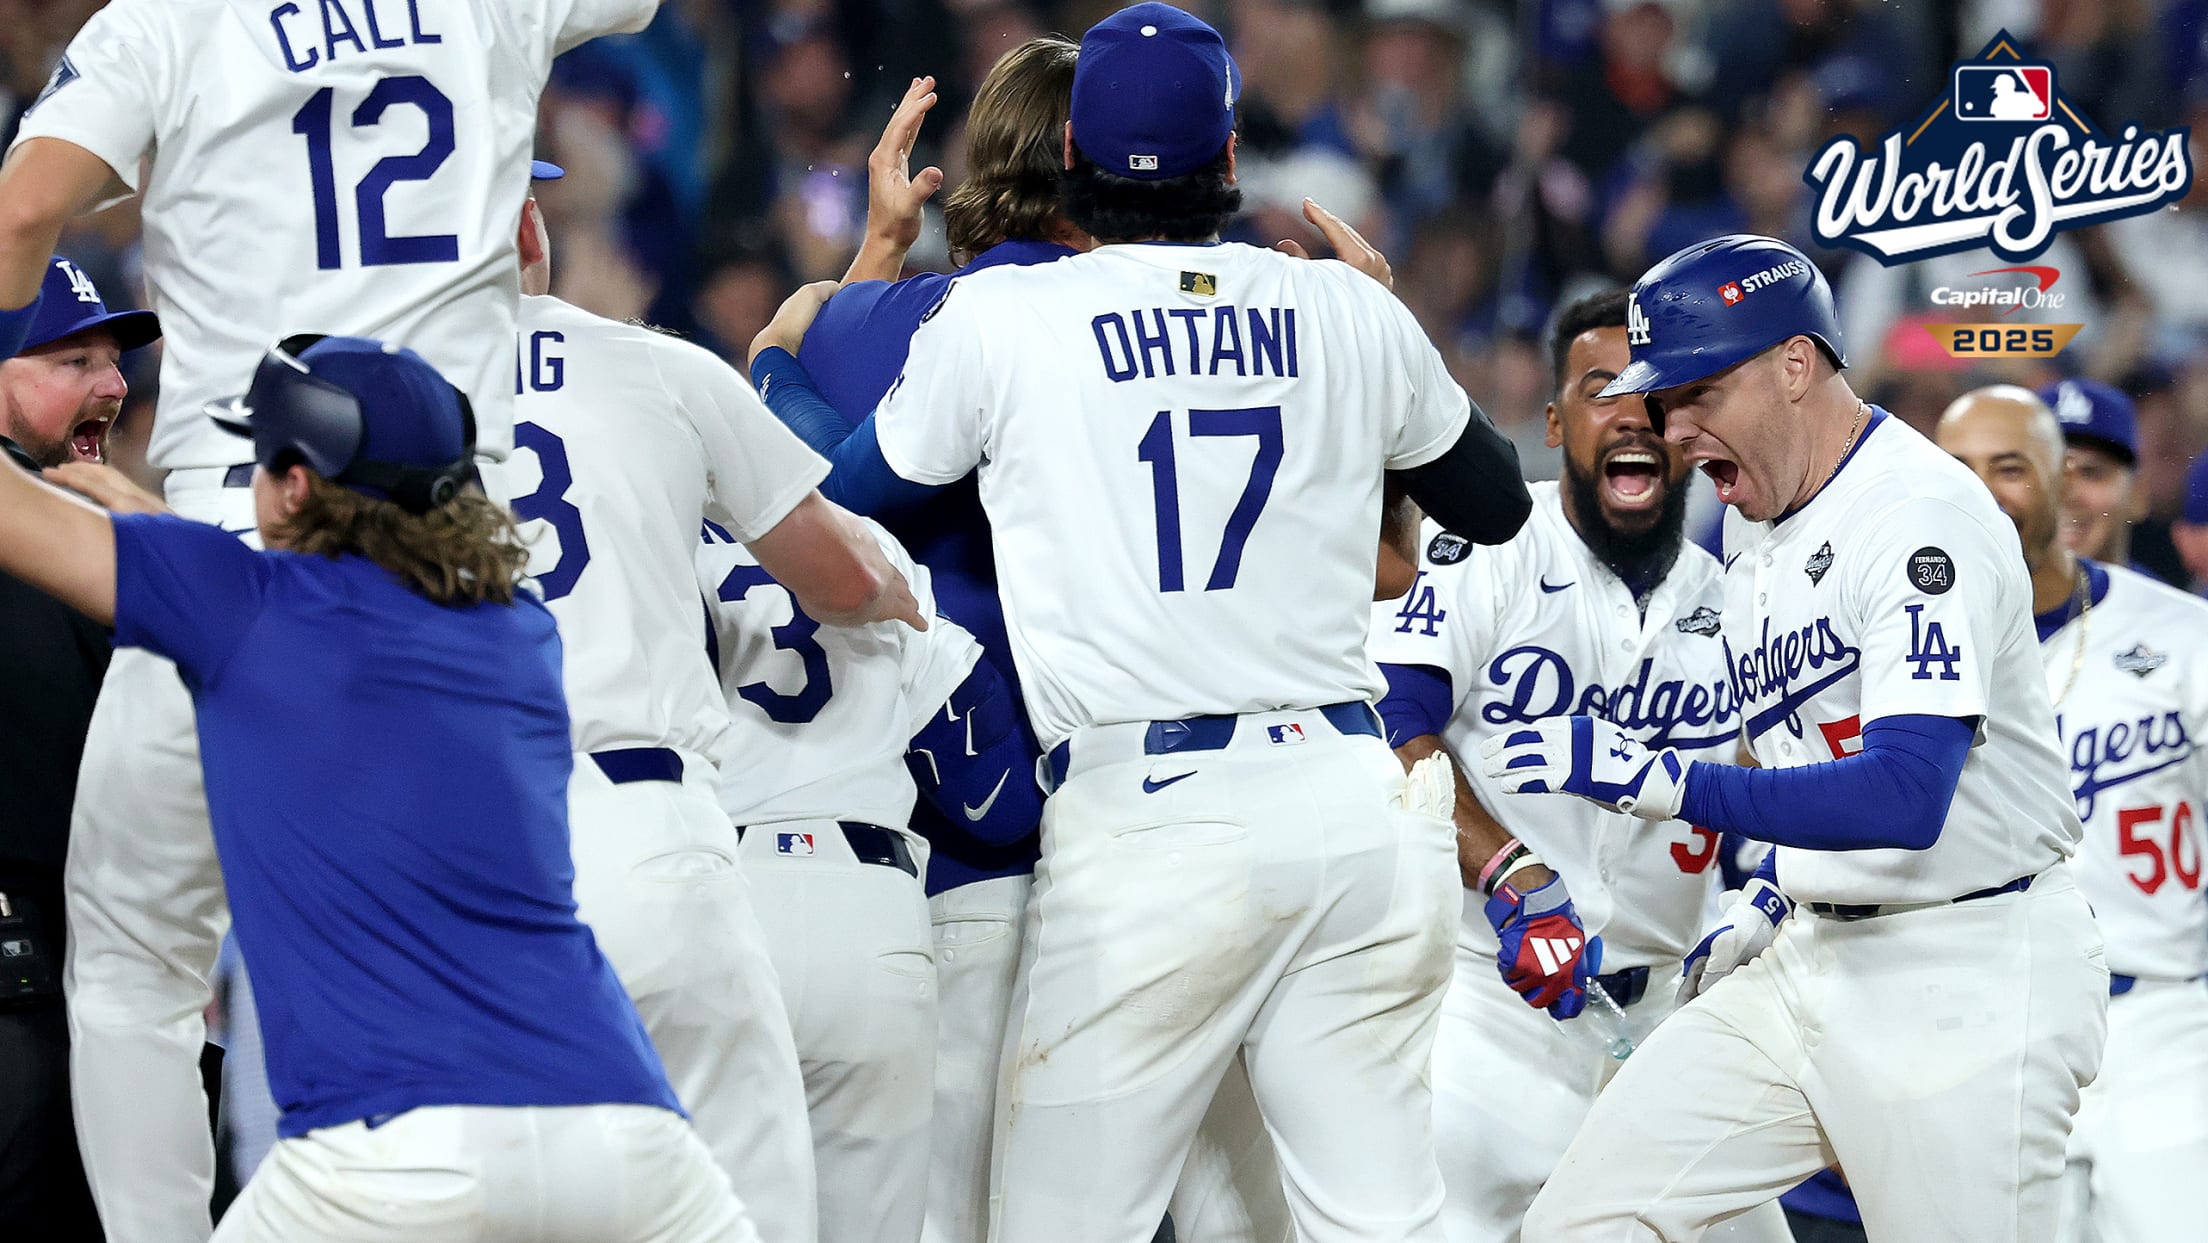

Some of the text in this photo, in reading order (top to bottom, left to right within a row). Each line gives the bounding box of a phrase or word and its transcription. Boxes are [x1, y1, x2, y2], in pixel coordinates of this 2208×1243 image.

[270, 0, 442, 73] CALL
[293, 75, 459, 270] 12
[56, 260, 100, 303] LA
[1741, 260, 1806, 293] STRAUSS
[1091, 306, 1298, 382] OHTANI
[1627, 293, 1651, 345] LA
[1138, 405, 1284, 592] 17
[1915, 556, 1947, 564] FERNANDO
[1917, 564, 1948, 586] 34
[1394, 571, 1446, 637] LA
[701, 565, 833, 724] 3
[1905, 604, 1961, 680] LA
[1722, 616, 1862, 739] odgers
[1670, 825, 1722, 874] 3
[2118, 801, 2201, 886] 50
[1763, 896, 1781, 915] 5
